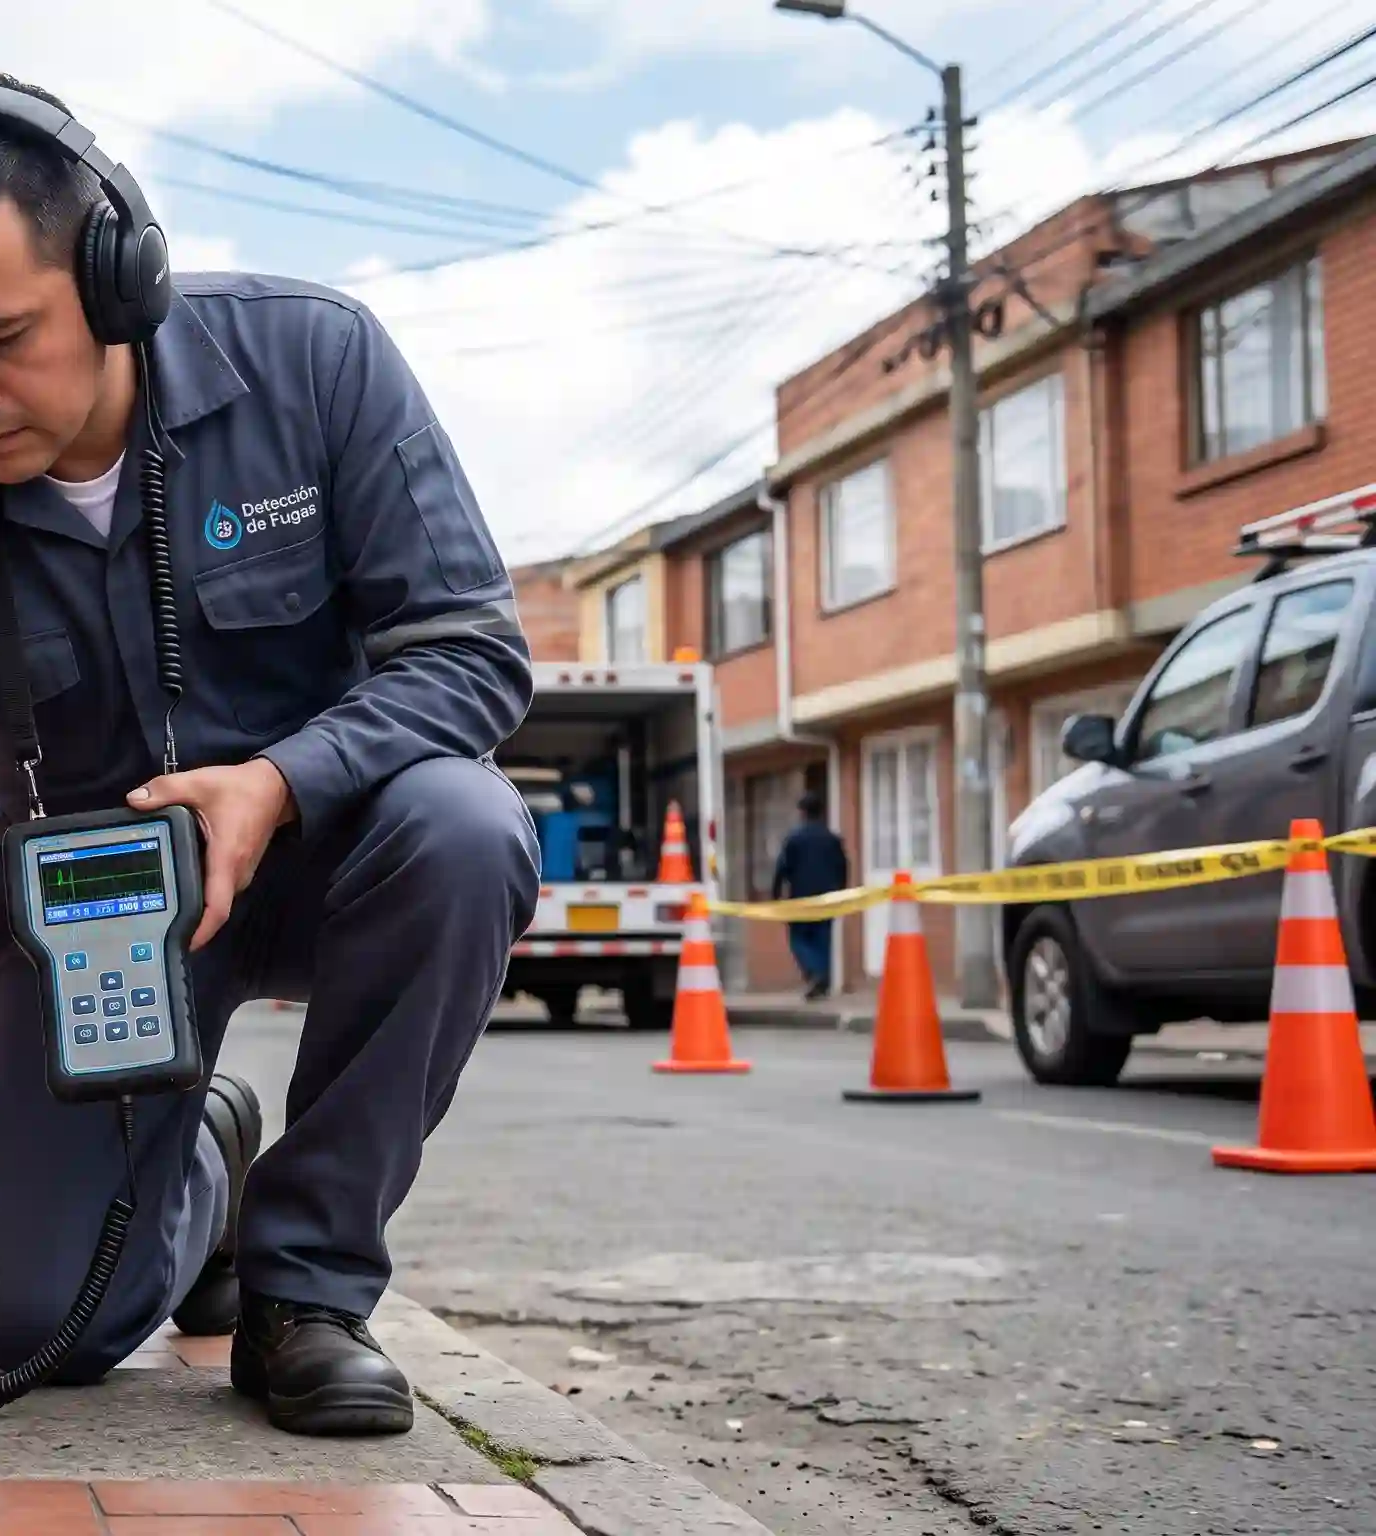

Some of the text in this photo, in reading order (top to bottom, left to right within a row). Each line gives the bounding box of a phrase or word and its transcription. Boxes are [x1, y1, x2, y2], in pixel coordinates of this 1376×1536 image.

[241, 485, 319, 518] Detección
[246, 503, 317, 534] de Fugas
